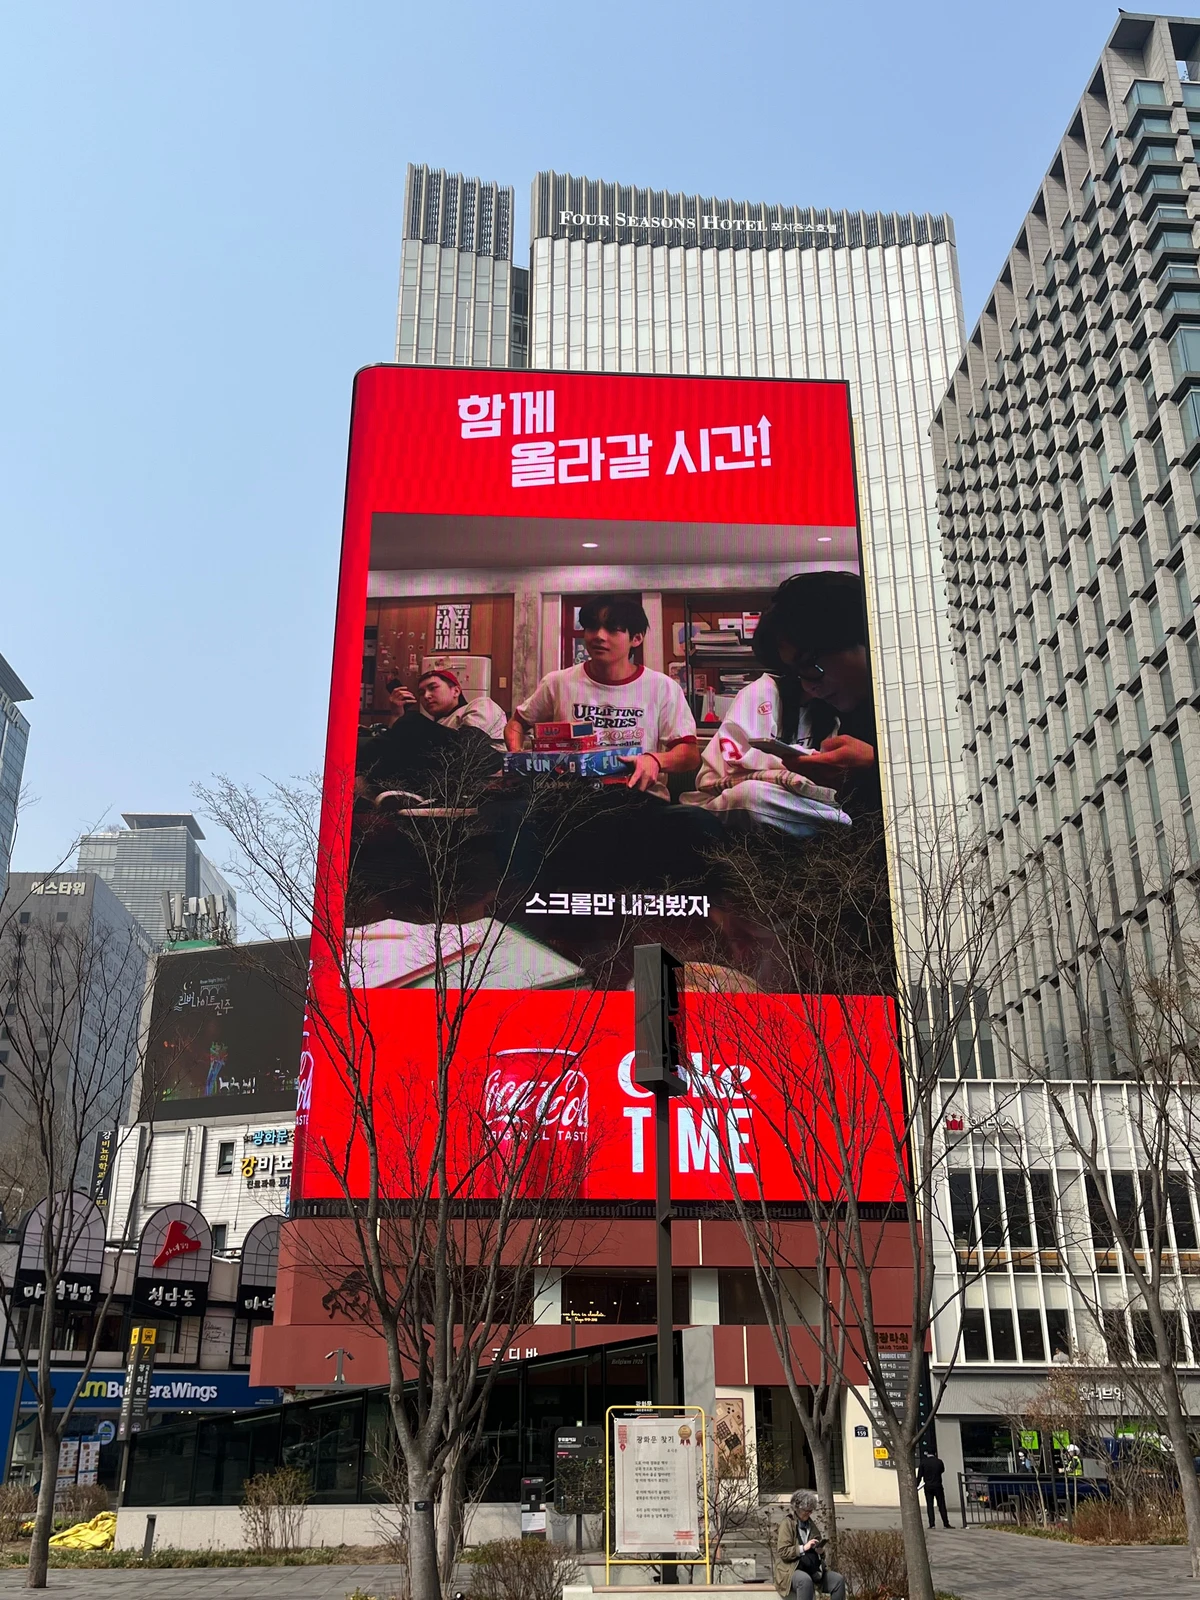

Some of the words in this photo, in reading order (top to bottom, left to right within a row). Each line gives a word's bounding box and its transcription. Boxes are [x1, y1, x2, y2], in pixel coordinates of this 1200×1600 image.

[559, 210, 610, 226] FOUR
[615, 212, 696, 229] SEASONS
[702, 215, 767, 231] HOTEL
[771, 222, 836, 233] 포시즌스호텔
[457, 390, 556, 439] 함께
[511, 433, 653, 488] 올라갈
[665, 414, 772, 475] 시간!
[435, 635, 469, 650] HARD
[573, 703, 644, 719] UPLIFTING
[584, 716, 637, 728] SERIES
[525, 758, 551, 772] FUN
[31, 881, 86, 896] 에스타워
[525, 892, 616, 916] 스크롤만
[620, 893, 711, 918] 내려봤자
[252, 1129, 288, 1146] 광화문
[623, 1106, 754, 1174] TME
[148, 1286, 196, 1308] 청담동
[876, 1332, 909, 1344] 광타워
[144, 1346, 150, 1355] 7
[636, 1435, 658, 1444] 광화문
